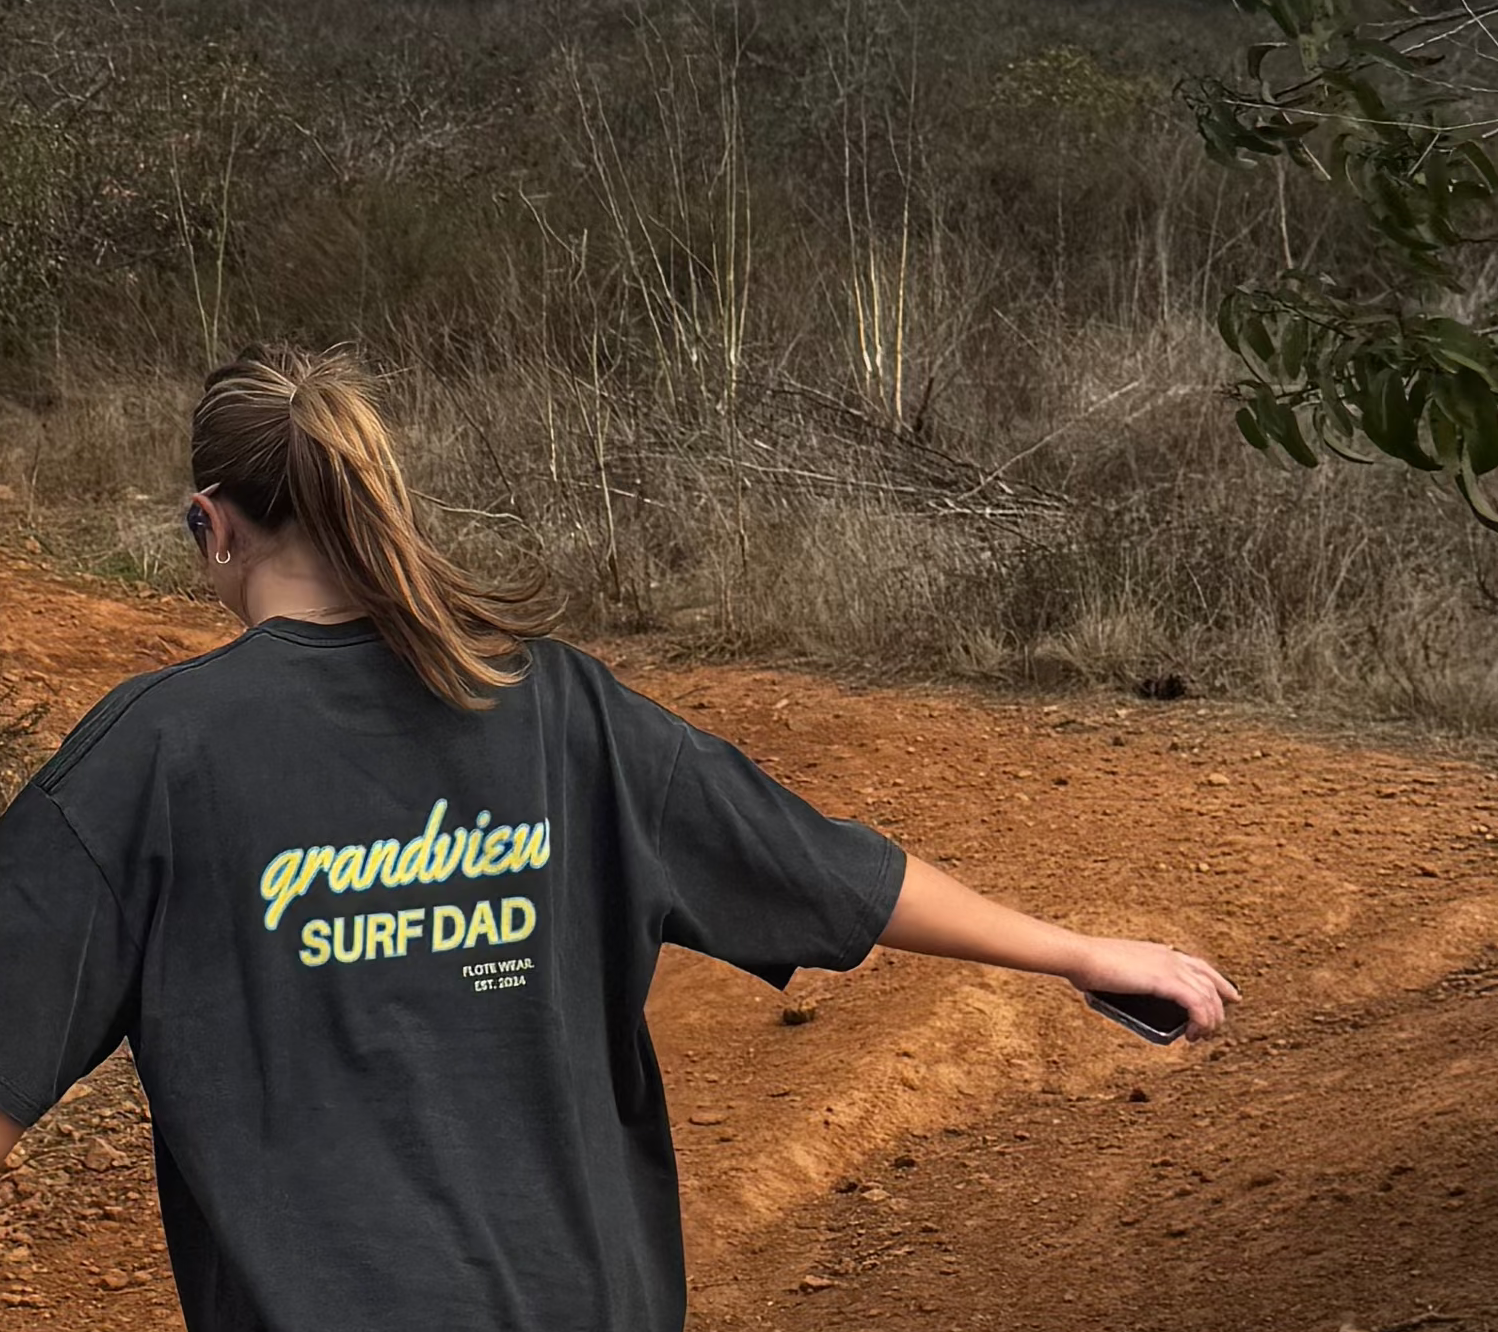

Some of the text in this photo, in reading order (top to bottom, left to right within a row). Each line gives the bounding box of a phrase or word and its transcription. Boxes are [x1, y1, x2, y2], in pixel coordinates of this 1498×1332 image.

[260, 797, 551, 931] grandview
[298, 896, 537, 968] SURF DAD
[474, 979, 497, 992] EST.
